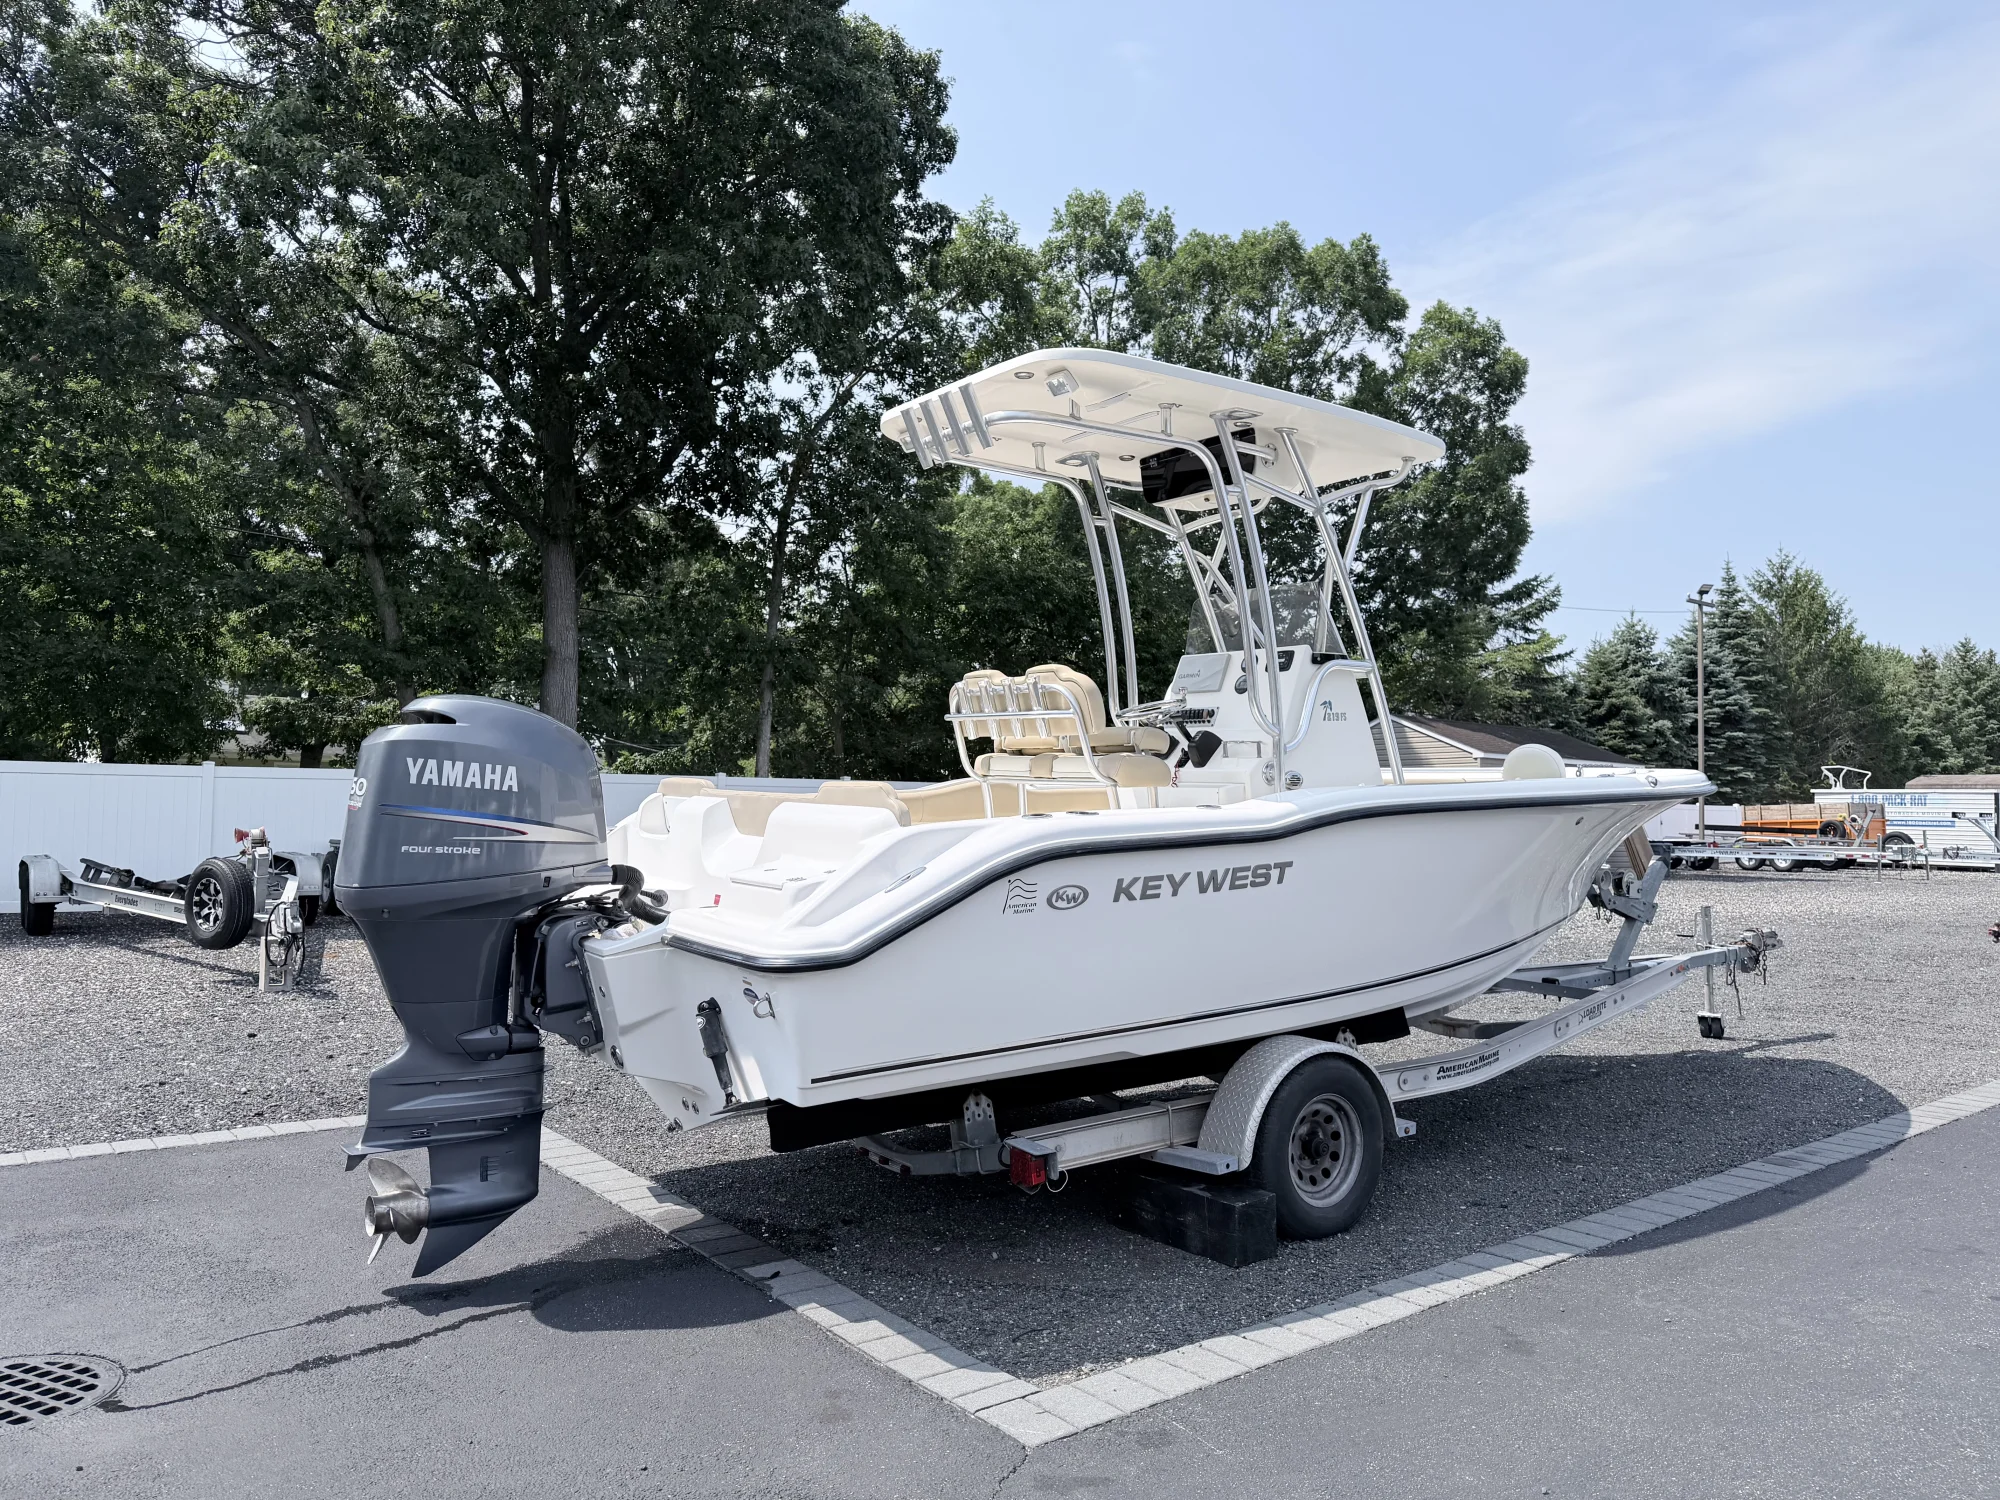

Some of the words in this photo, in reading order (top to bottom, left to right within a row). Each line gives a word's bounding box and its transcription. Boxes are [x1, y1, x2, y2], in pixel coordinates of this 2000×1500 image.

[406, 757, 519, 792] YAMAHA
[1112, 871, 1192, 903] KEY
[1196, 860, 1294, 894] WEST
